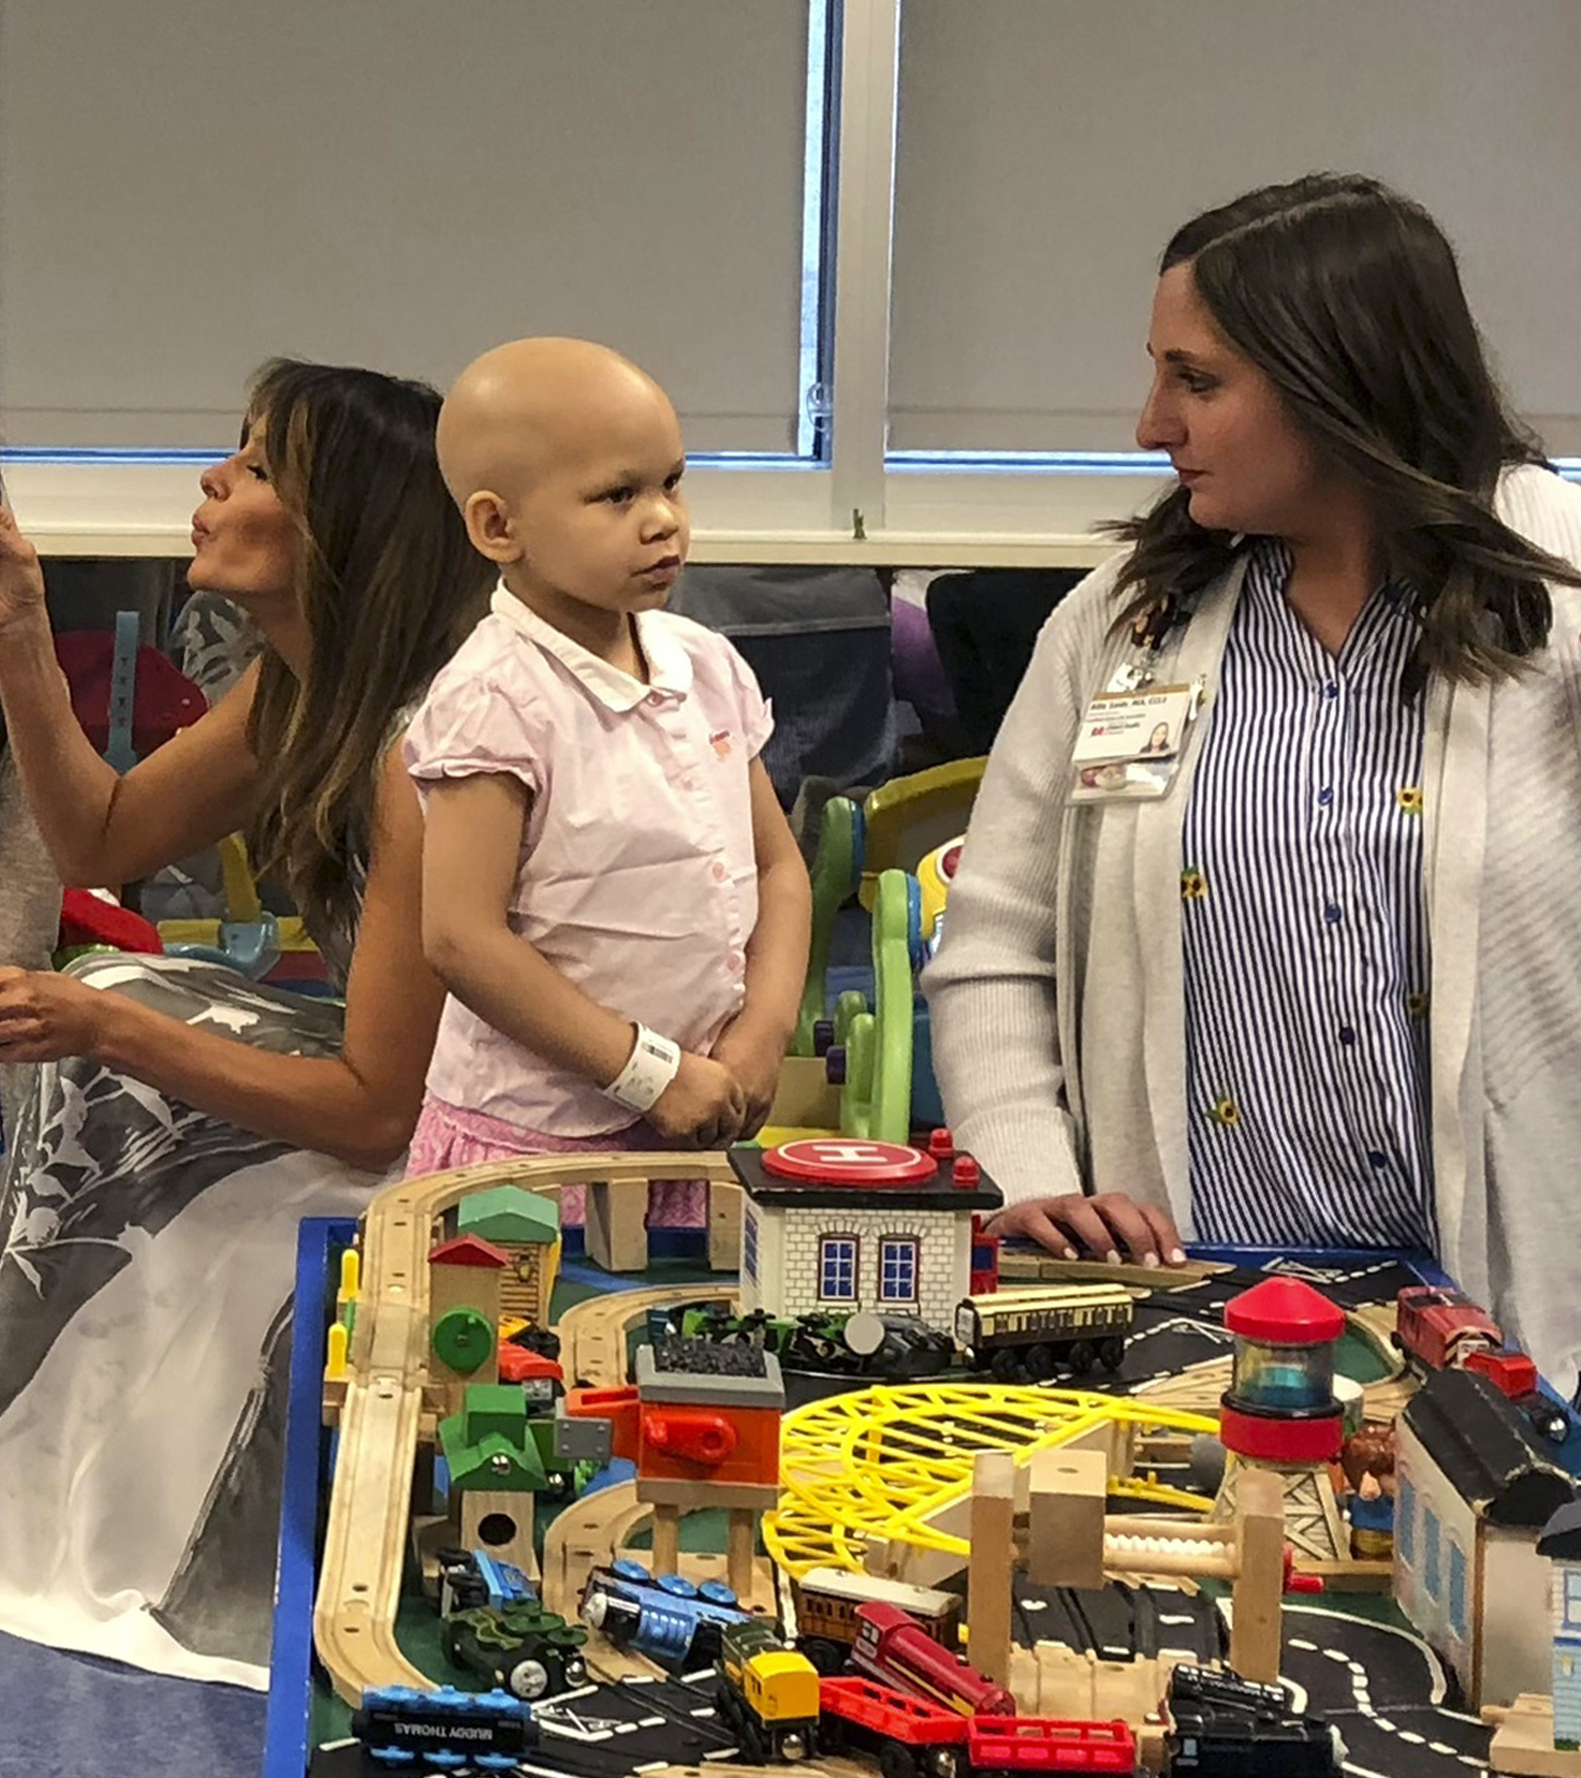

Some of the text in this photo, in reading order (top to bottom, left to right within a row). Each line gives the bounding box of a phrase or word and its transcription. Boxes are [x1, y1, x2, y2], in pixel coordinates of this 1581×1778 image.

[813, 1145, 889, 1162] H
[394, 1722, 493, 1740] MUDDY THOMAS
